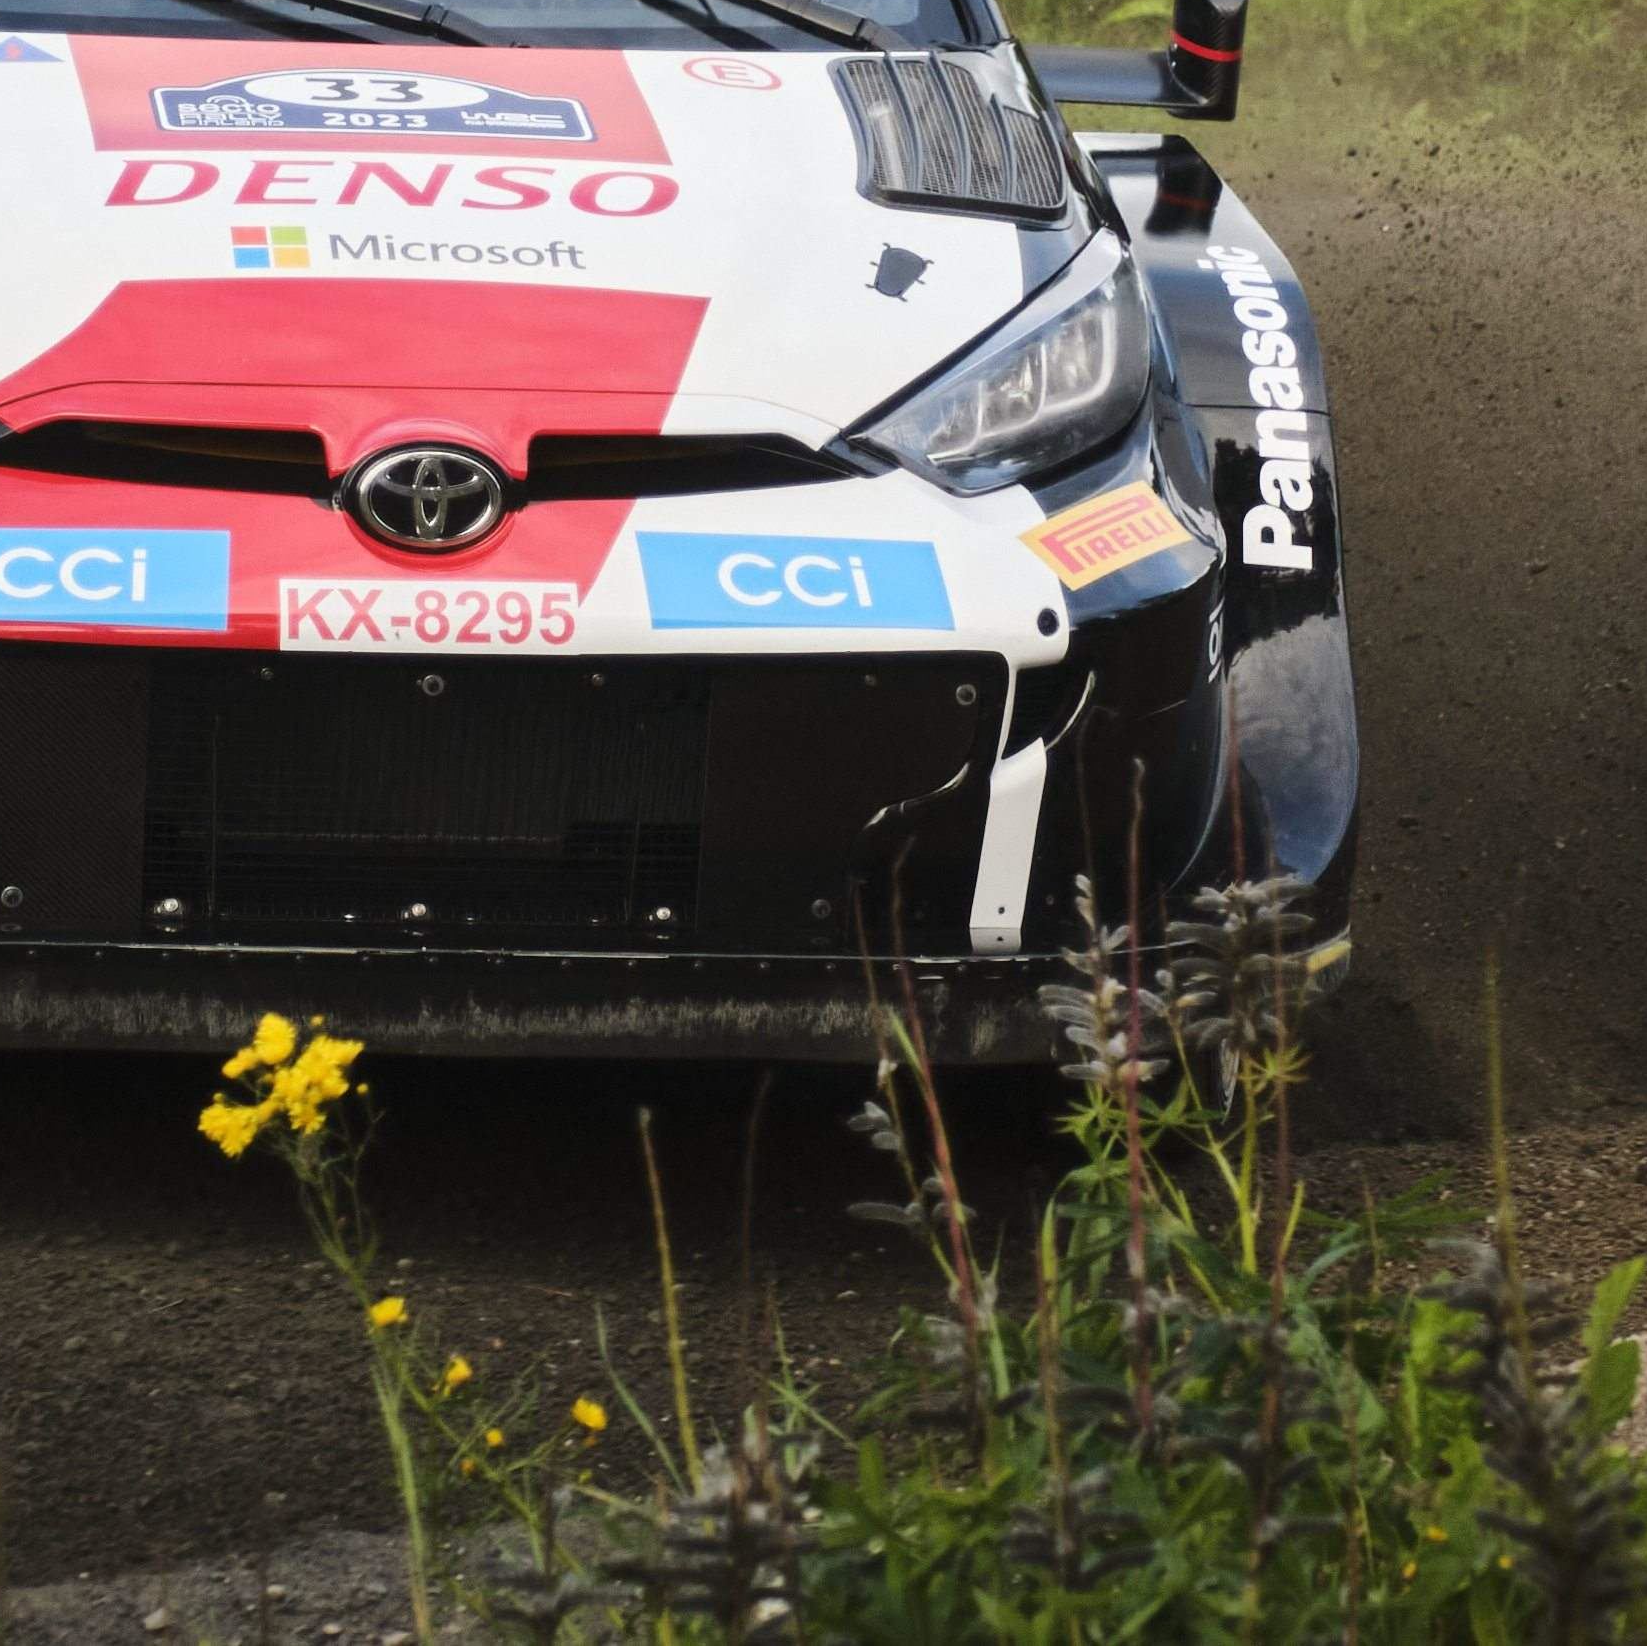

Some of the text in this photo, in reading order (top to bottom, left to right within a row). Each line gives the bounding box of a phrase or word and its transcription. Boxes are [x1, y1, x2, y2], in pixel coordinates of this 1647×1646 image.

[305, 76, 425, 104] 33
[322, 111, 429, 128] 2023
[104, 159, 680, 218] DENSO
[329, 233, 587, 271] Microsoft
[1197, 244, 1314, 571] Panasonic
[1038, 492, 1176, 574] PIRELLI
[286, 586, 577, 646] KX-8295
